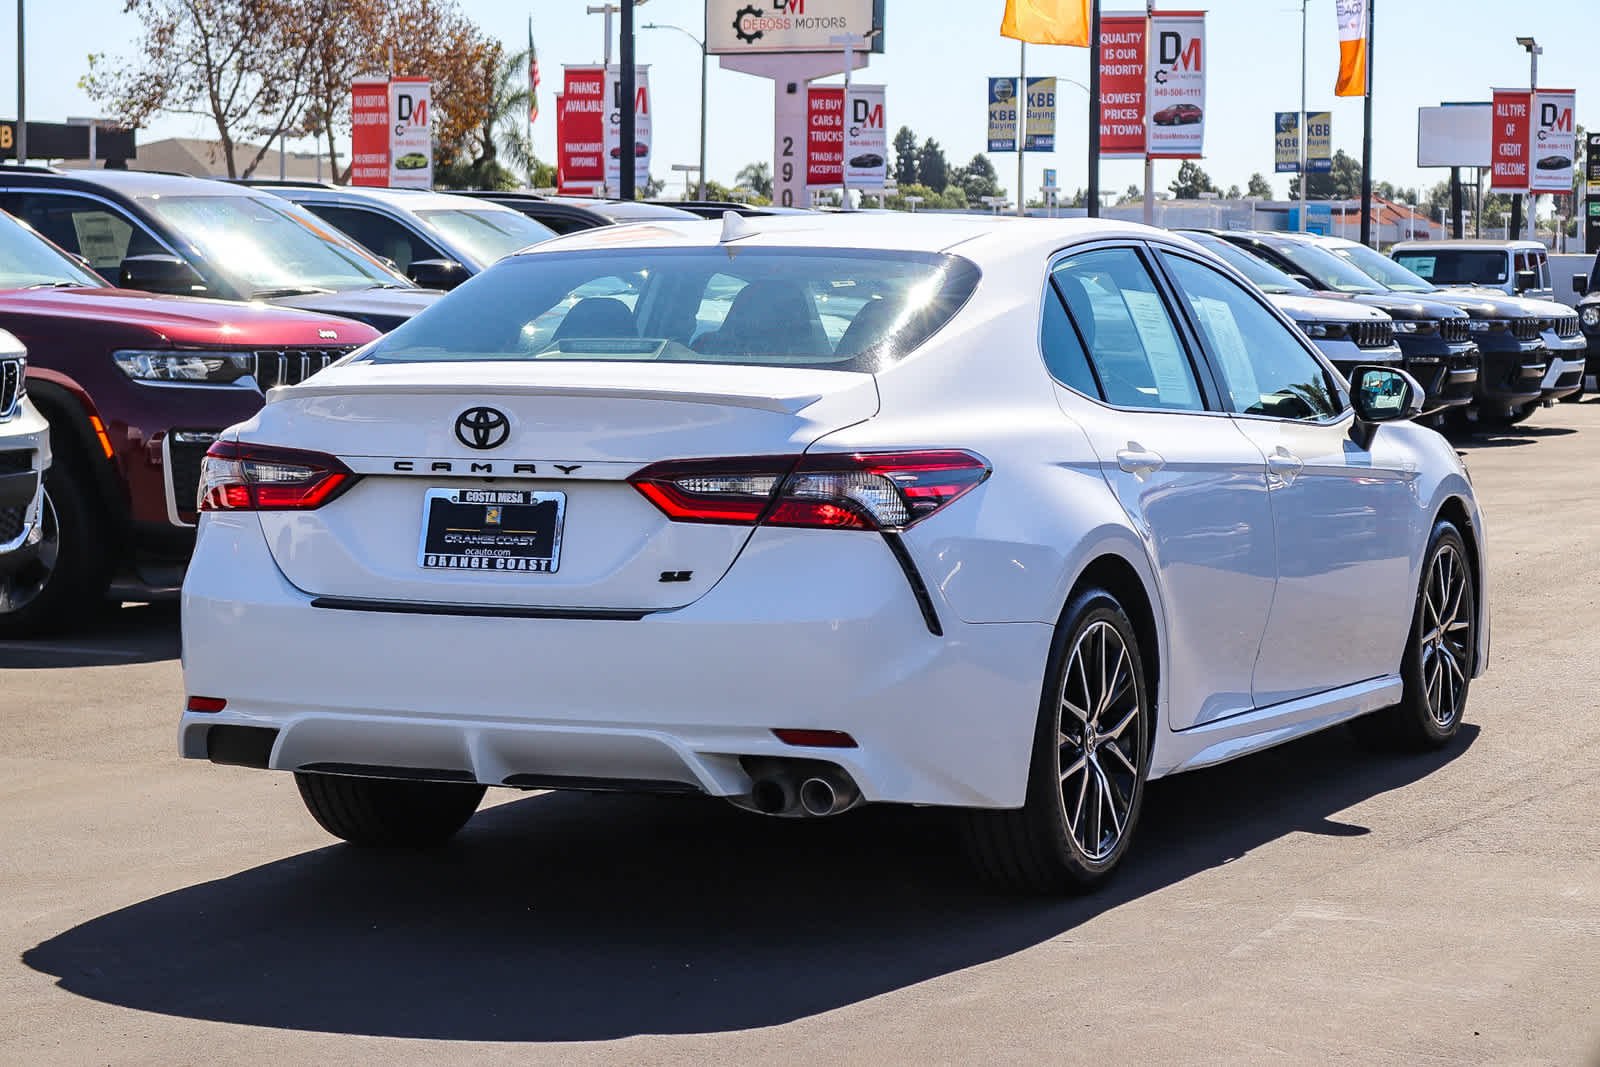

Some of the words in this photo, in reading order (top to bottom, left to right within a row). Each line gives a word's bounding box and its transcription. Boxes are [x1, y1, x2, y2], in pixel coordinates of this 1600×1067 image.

[743, 18, 791, 30] DEBOSS
[795, 17, 847, 29] MOTORS
[1100, 33, 1142, 44] QUALITY
[1105, 49, 1114, 60] IS
[1116, 49, 1137, 60] OUR
[1099, 64, 1143, 75] PRIORITY
[569, 82, 600, 94] FINANCE
[811, 99, 825, 110] WE
[826, 99, 842, 109] BUY
[1027, 93, 1055, 107] KBB
[990, 110, 1016, 121] KBB
[1104, 109, 1138, 120] PRICES
[1497, 104, 1510, 117] ALL
[1511, 104, 1526, 117] TYPE
[812, 115, 834, 126] CARS
[834, 115, 842, 126] &
[1100, 125, 1113, 135] IN
[1114, 125, 1142, 135] TOWN
[1307, 124, 1330, 136] KBB
[1505, 123, 1516, 137] OF
[811, 131, 843, 142] TRUCKS
[1499, 144, 1522, 156] CREDIT
[811, 152, 842, 161] TRADE-IN
[1494, 162, 1526, 175] WELCOME
[393, 460, 583, 475] CAMRY
[466, 491, 496, 503] COSTA
[497, 492, 524, 504] MESA
[444, 533, 496, 545] ORANGE
[496, 534, 536, 546] COAST
[465, 548, 511, 557] ocauto.com
[427, 555, 489, 569] ORANGE
[495, 558, 548, 572] COAST
